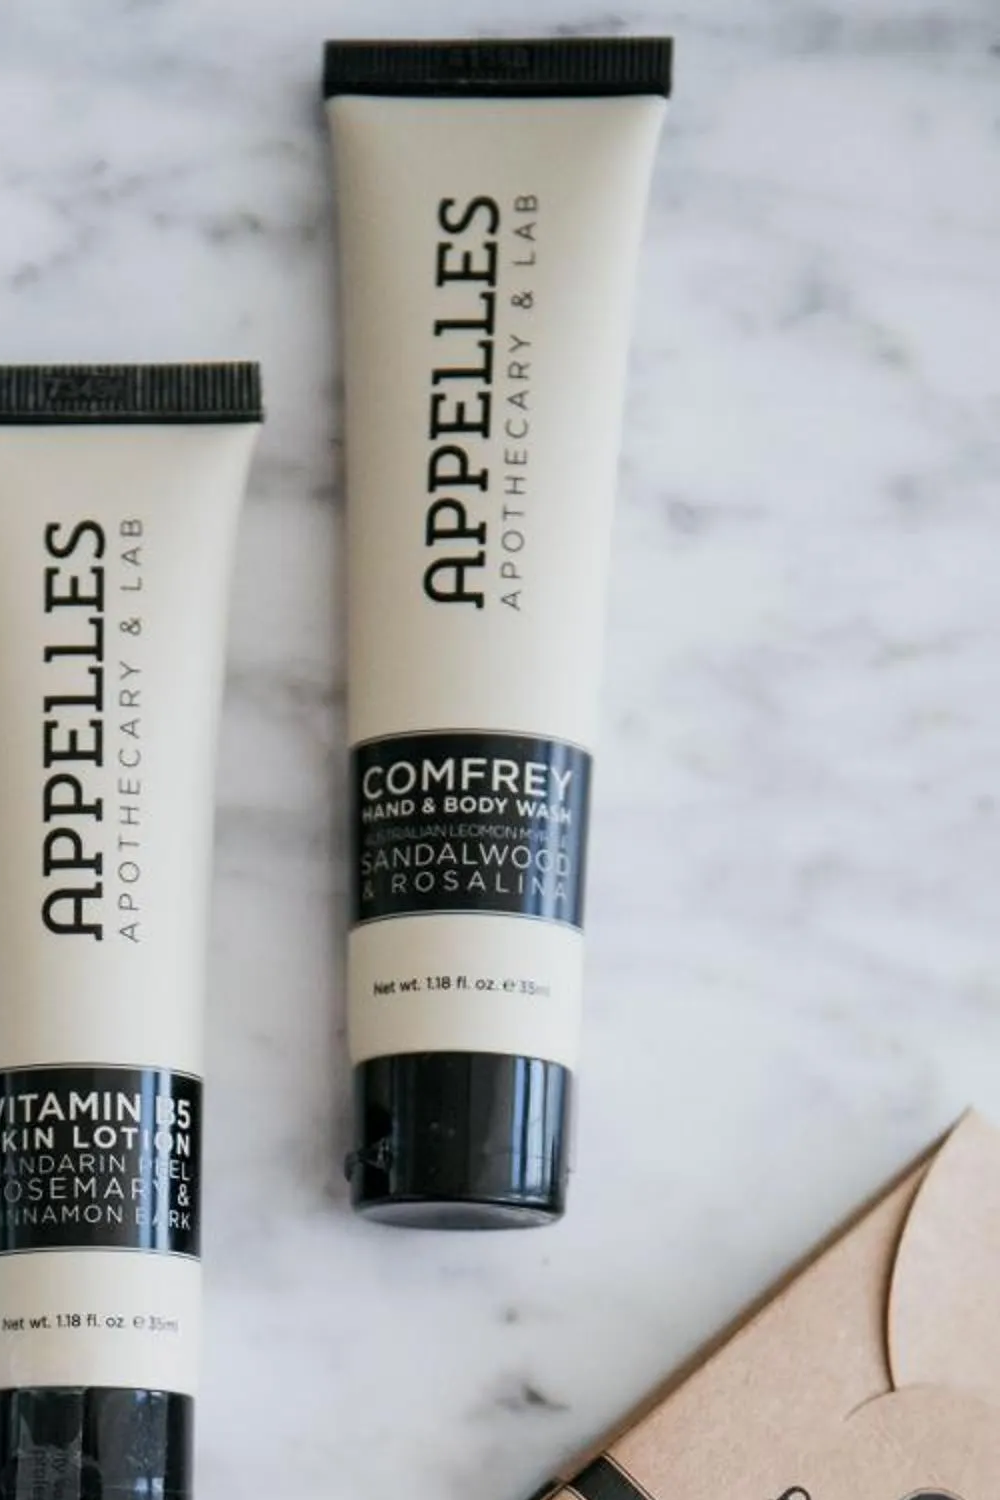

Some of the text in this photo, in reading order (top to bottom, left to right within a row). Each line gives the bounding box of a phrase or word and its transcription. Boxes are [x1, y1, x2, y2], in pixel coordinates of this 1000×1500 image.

[423, 194, 500, 610] APPELLES
[500, 192, 539, 611] APOTHECARY & LAB
[41, 519, 106, 942] APPELLES
[118, 517, 143, 943] APOTHECARY & LAB
[362, 757, 573, 801] COMFREY
[362, 796, 572, 825] HAND & BODY WASH
[361, 842, 571, 876] SANDALWOOD
[391, 869, 567, 899] ROSALINA
[373, 980, 396, 995] Net
[155, 1095, 191, 1130] B5
[73, 1125, 190, 1157] LOTION
[177, 1184, 190, 1206] &
[2, 1317, 25, 1332] Net
